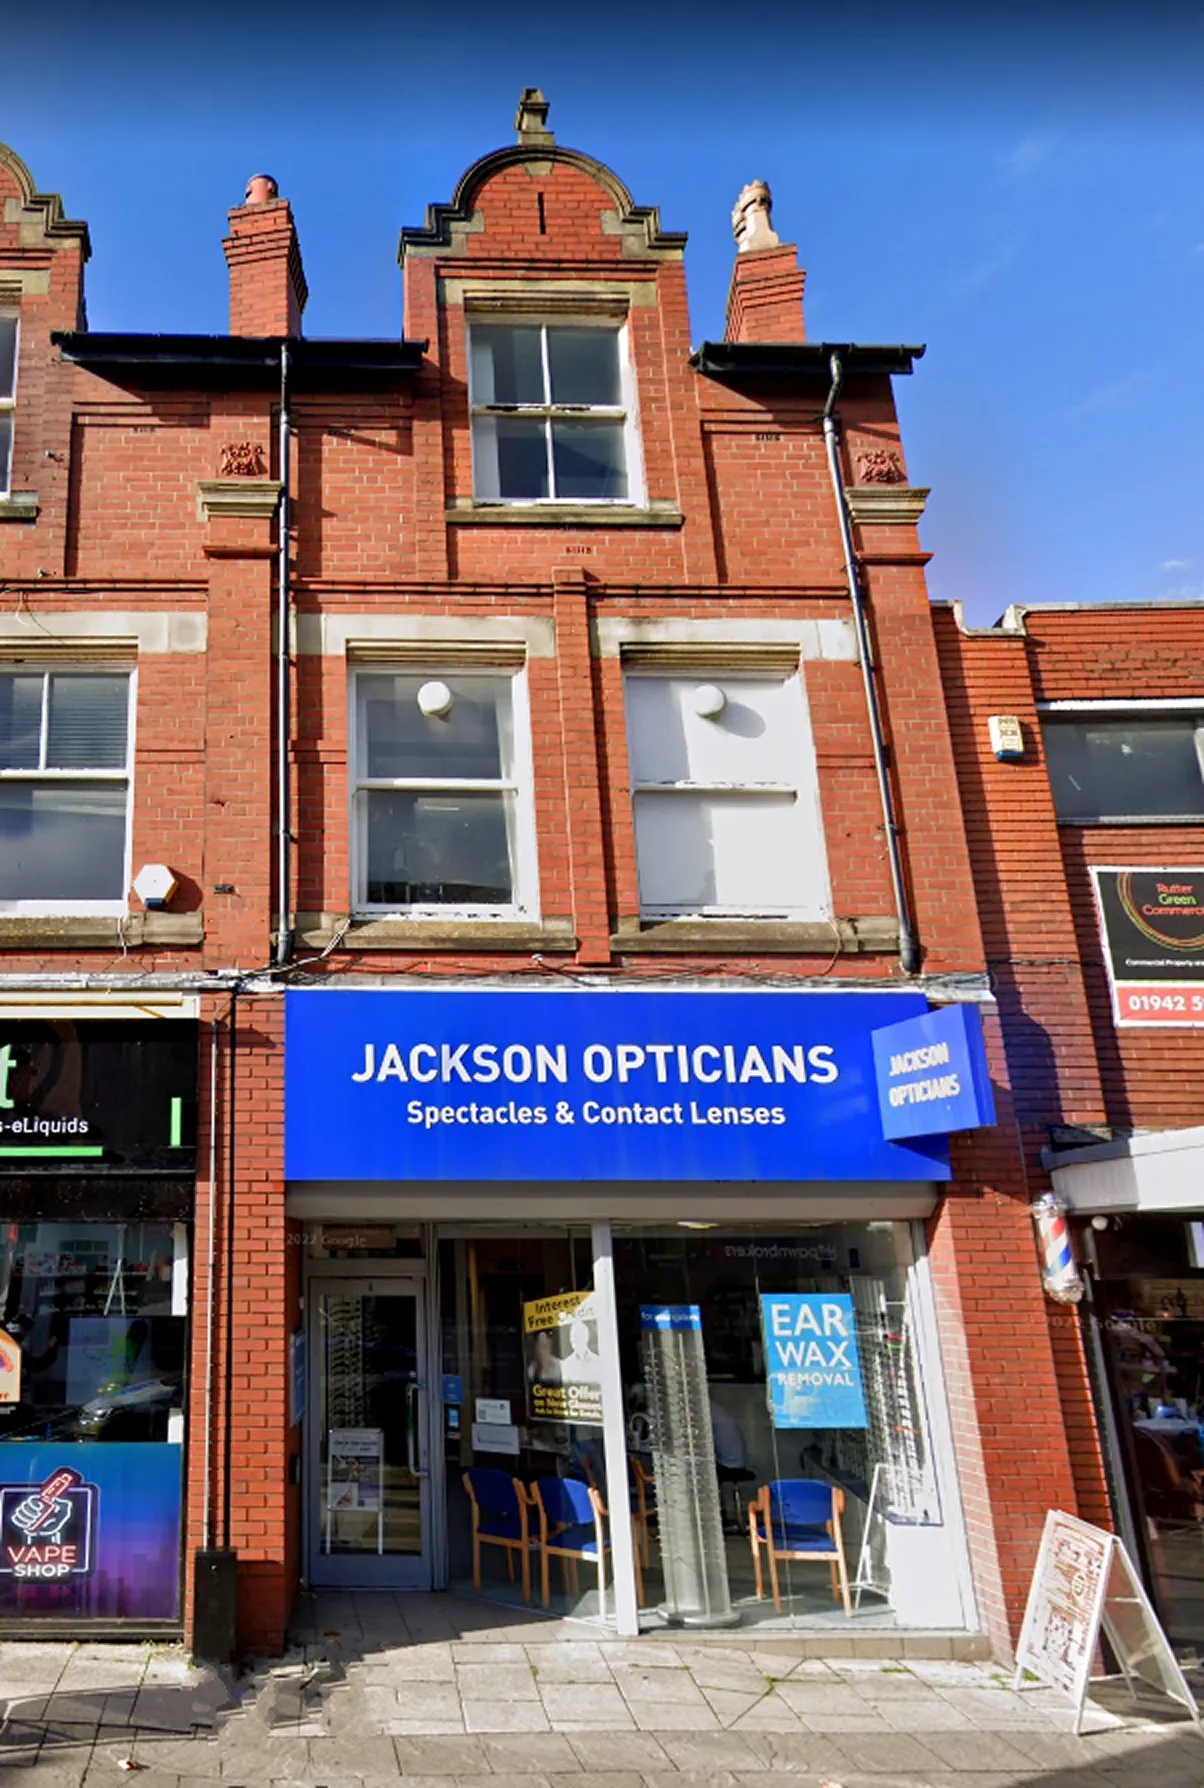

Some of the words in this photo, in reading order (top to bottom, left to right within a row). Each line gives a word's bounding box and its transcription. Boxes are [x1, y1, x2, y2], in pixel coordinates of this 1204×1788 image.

[1156, 883, 1193, 894] Rutter
[1159, 894, 1197, 905] Green
[1129, 995, 1186, 1012] 01942
[1192, 996, 1204, 1011] 5
[351, 1043, 569, 1083] JACKSON
[582, 1044, 839, 1084] OPTICIANS
[889, 1041, 950, 1077] JACKSON
[889, 1073, 961, 1107] OPTICIANS
[407, 1101, 548, 1129] Spectacles
[555, 1101, 575, 1124] &
[582, 1101, 684, 1124] Contact
[690, 1101, 787, 1125] Lenses
[535, 1294, 581, 1313] Interest
[527, 1315, 556, 1329] Free
[771, 1303, 849, 1337] EAR
[775, 1341, 853, 1369] WAX
[777, 1371, 855, 1388] REMOVAL
[532, 1384, 566, 1398] Great
[7, 1546, 77, 1563] VAPE
[14, 1563, 71, 1577] SHOP
